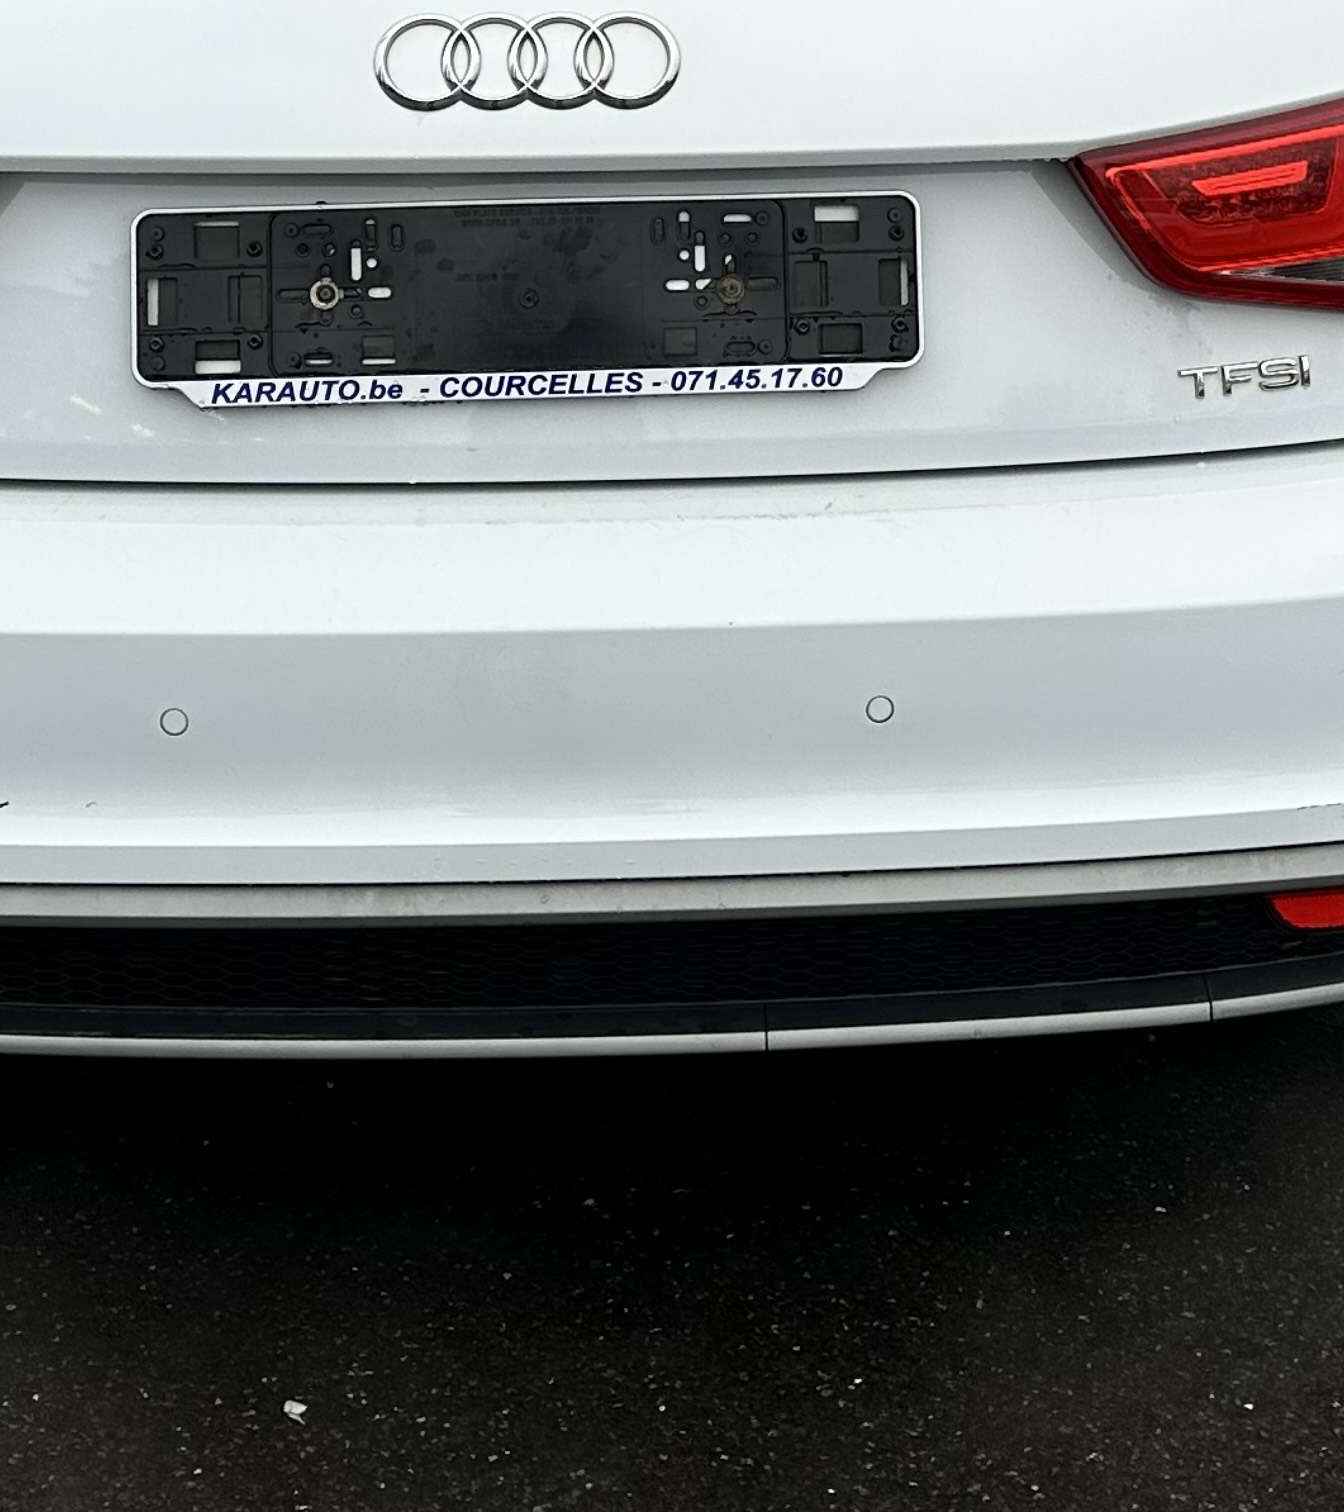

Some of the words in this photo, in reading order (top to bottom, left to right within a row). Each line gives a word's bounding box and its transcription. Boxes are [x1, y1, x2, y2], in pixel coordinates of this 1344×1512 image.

[211, 379, 403, 404] KARAUTO.be
[440, 371, 643, 398] COURCELLES
[670, 366, 844, 392] 071.45.17.60
[1177, 354, 1312, 399] TFSI
